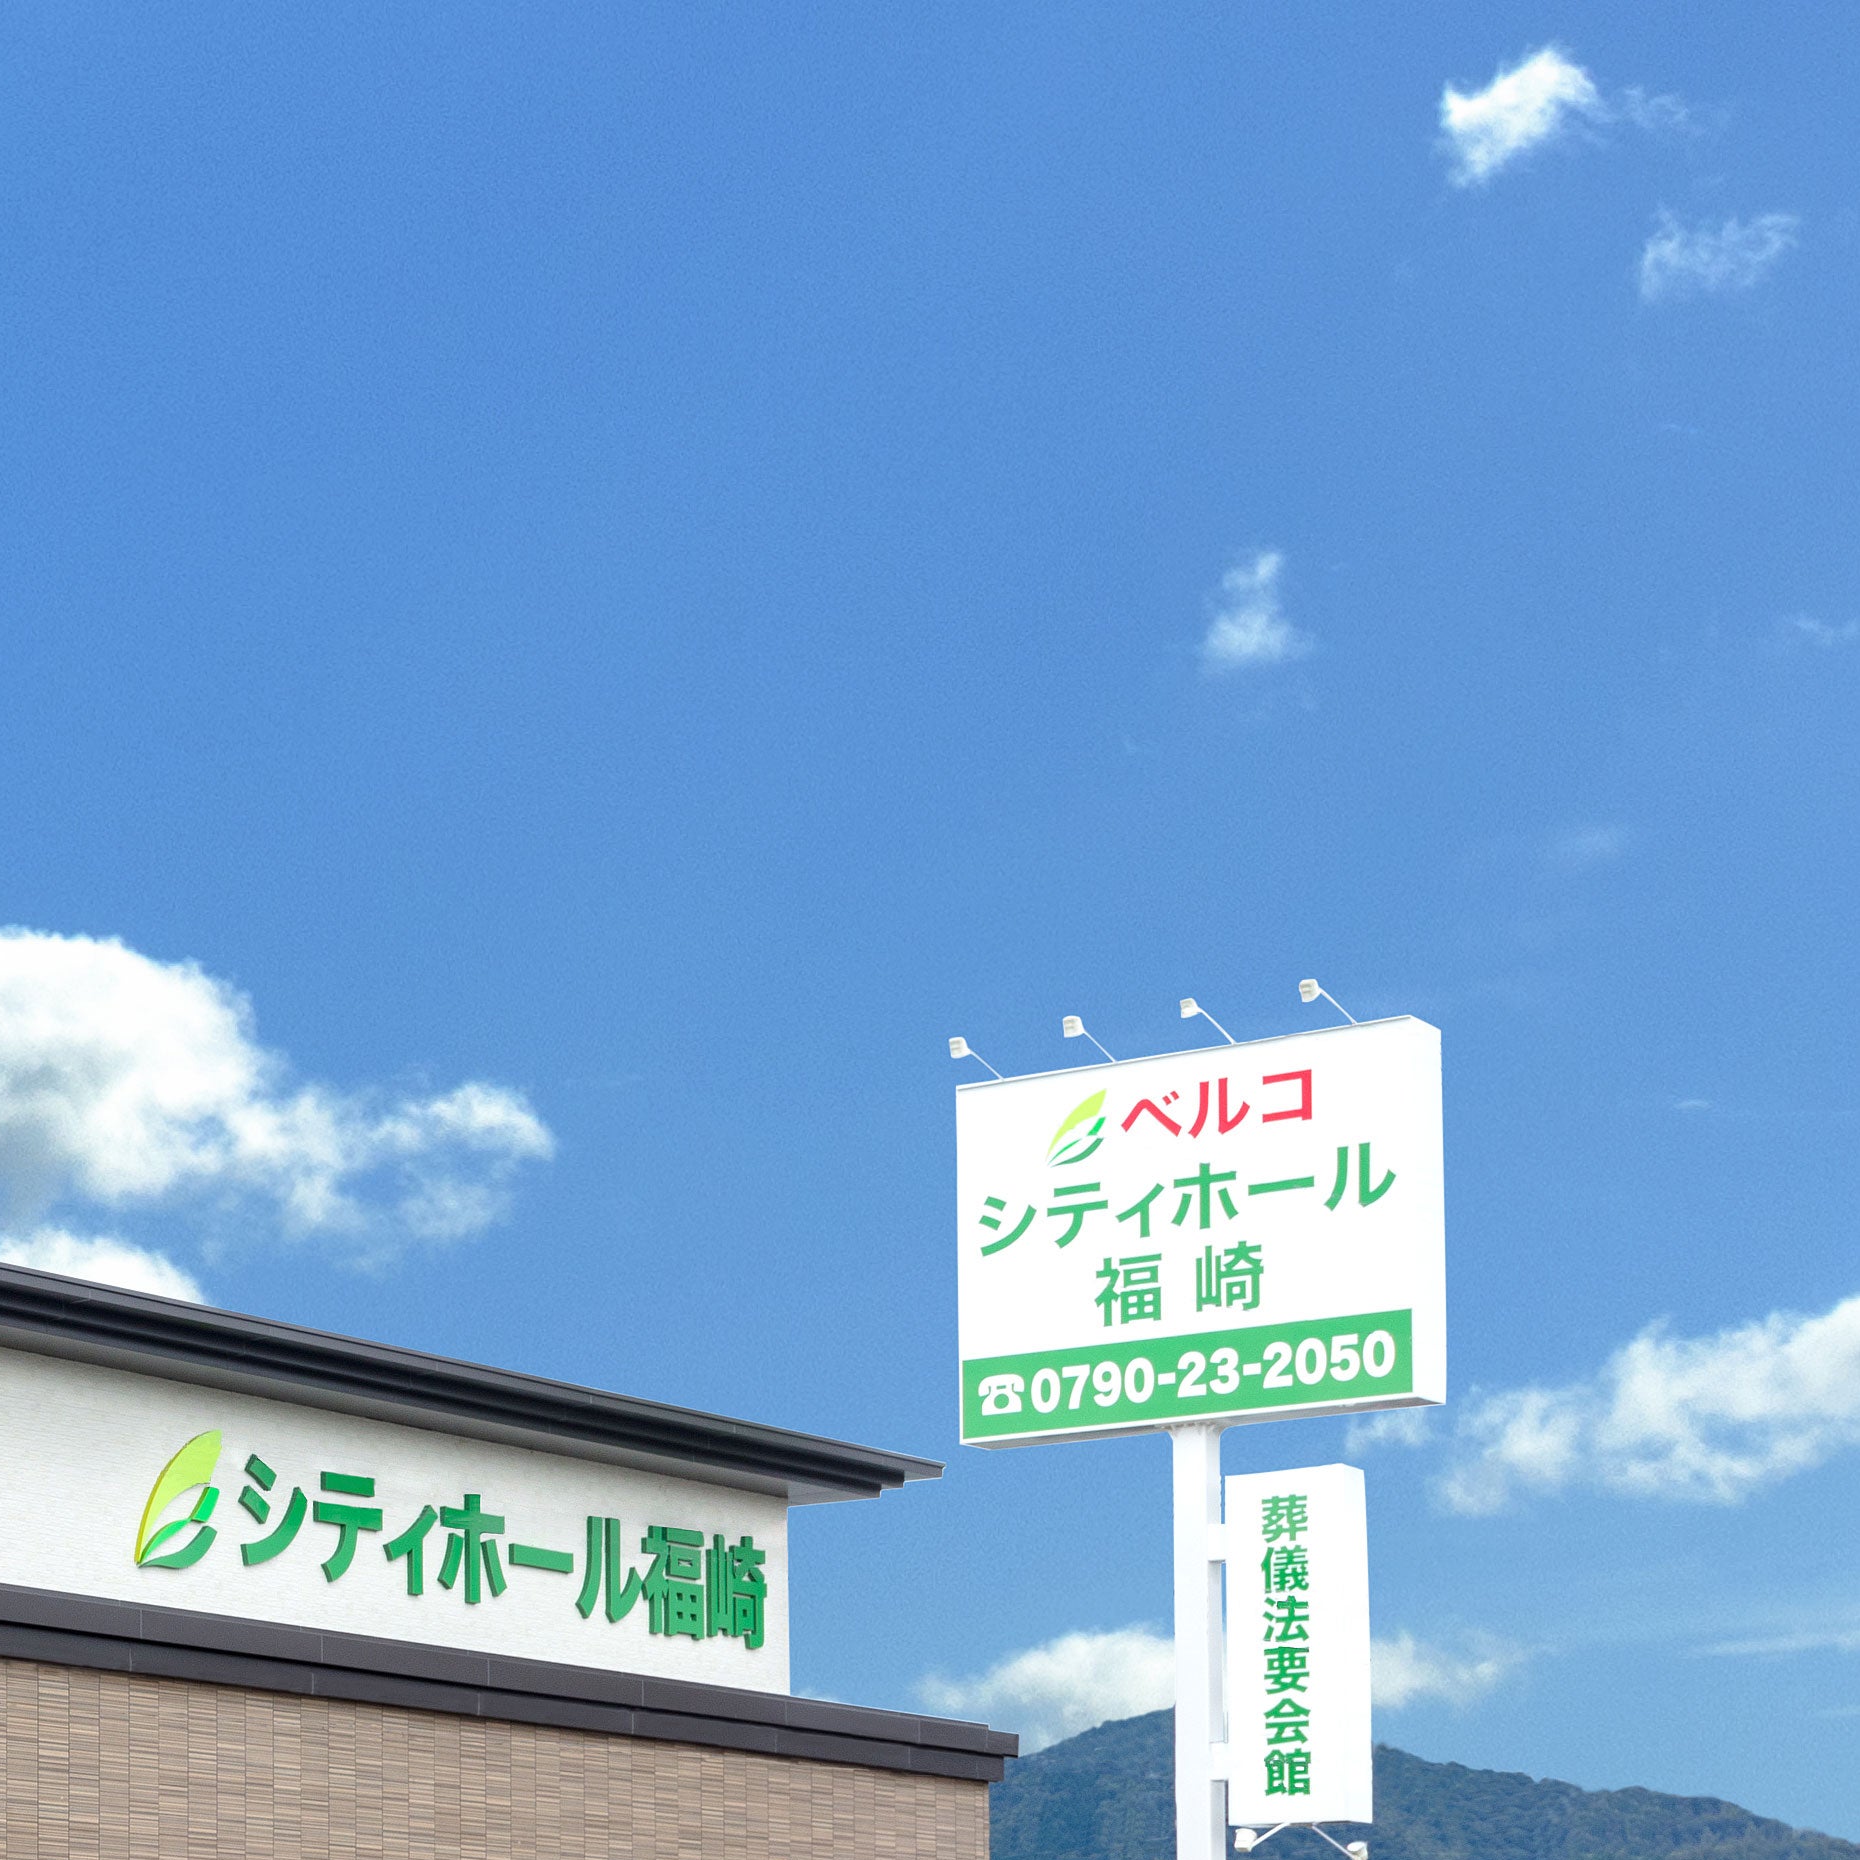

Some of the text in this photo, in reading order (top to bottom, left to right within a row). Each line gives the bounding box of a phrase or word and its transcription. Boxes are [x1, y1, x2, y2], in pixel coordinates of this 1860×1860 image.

[1121, 1068, 1314, 1140] ベルコ
[979, 1142, 1396, 1257] シティホール
[1094, 1240, 1265, 1327] 福崎
[1031, 1330, 1396, 1413] 0790-23-2050
[238, 1454, 767, 1650] シティホール福崎
[1261, 1494, 1311, 1796] 葬儀法要会館
